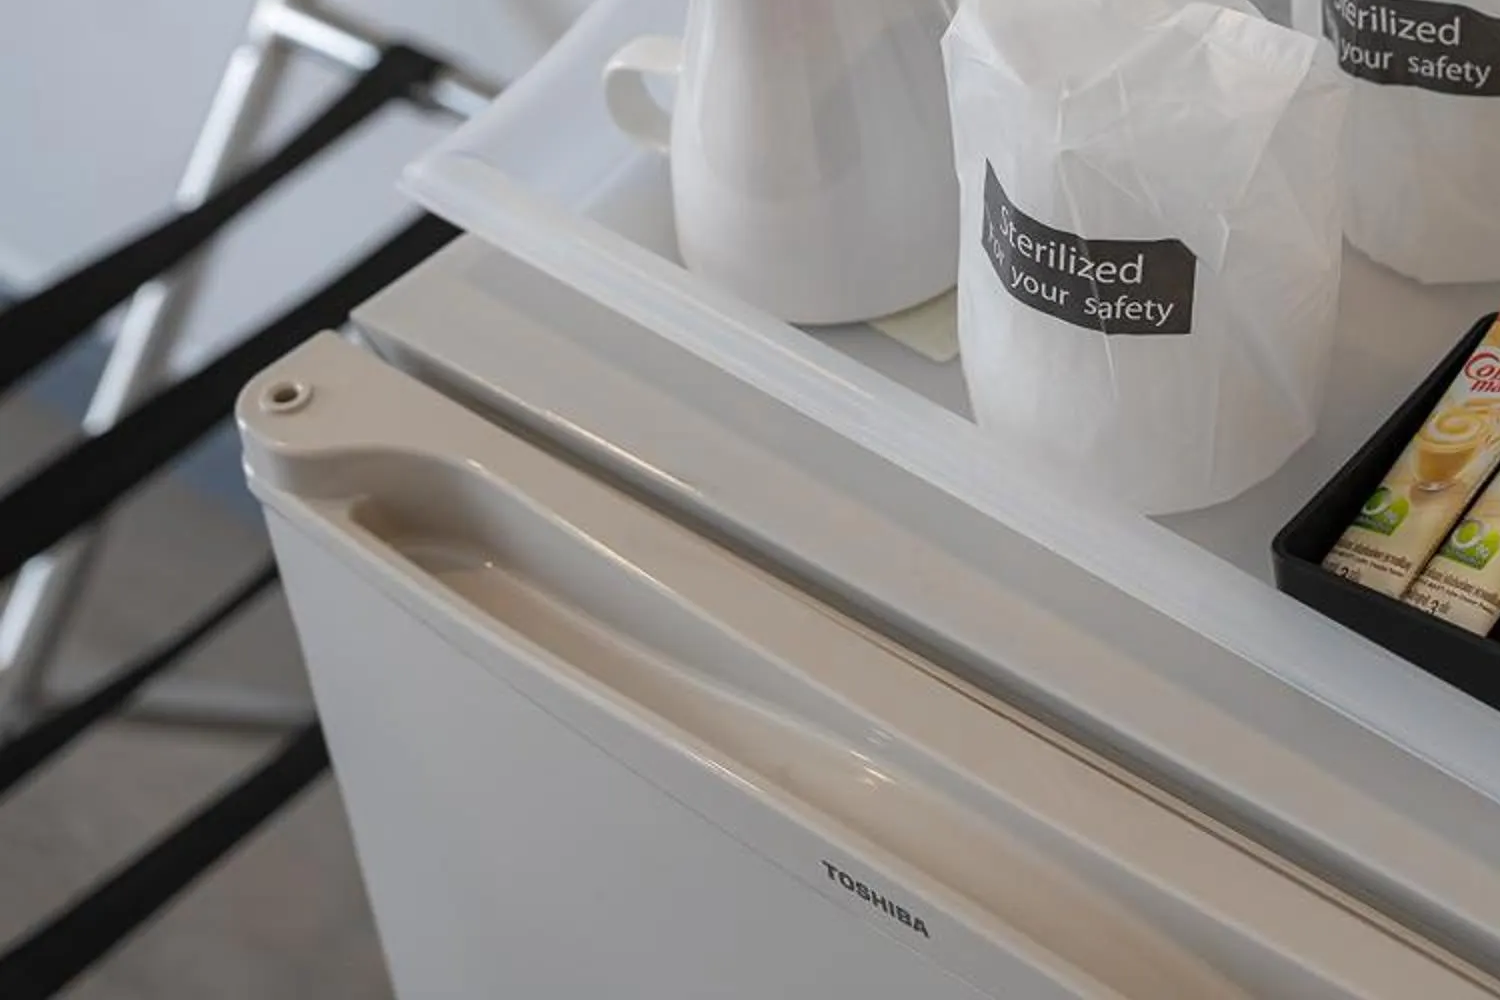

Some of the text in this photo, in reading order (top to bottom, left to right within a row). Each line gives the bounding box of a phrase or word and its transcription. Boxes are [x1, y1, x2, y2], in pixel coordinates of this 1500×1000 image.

[1340, 38, 1493, 89] your safety
[998, 205, 1145, 287] Sterilized
[1009, 264, 1071, 306] your
[1083, 294, 1175, 328] safety
[820, 858, 931, 940] TOSHIBA
